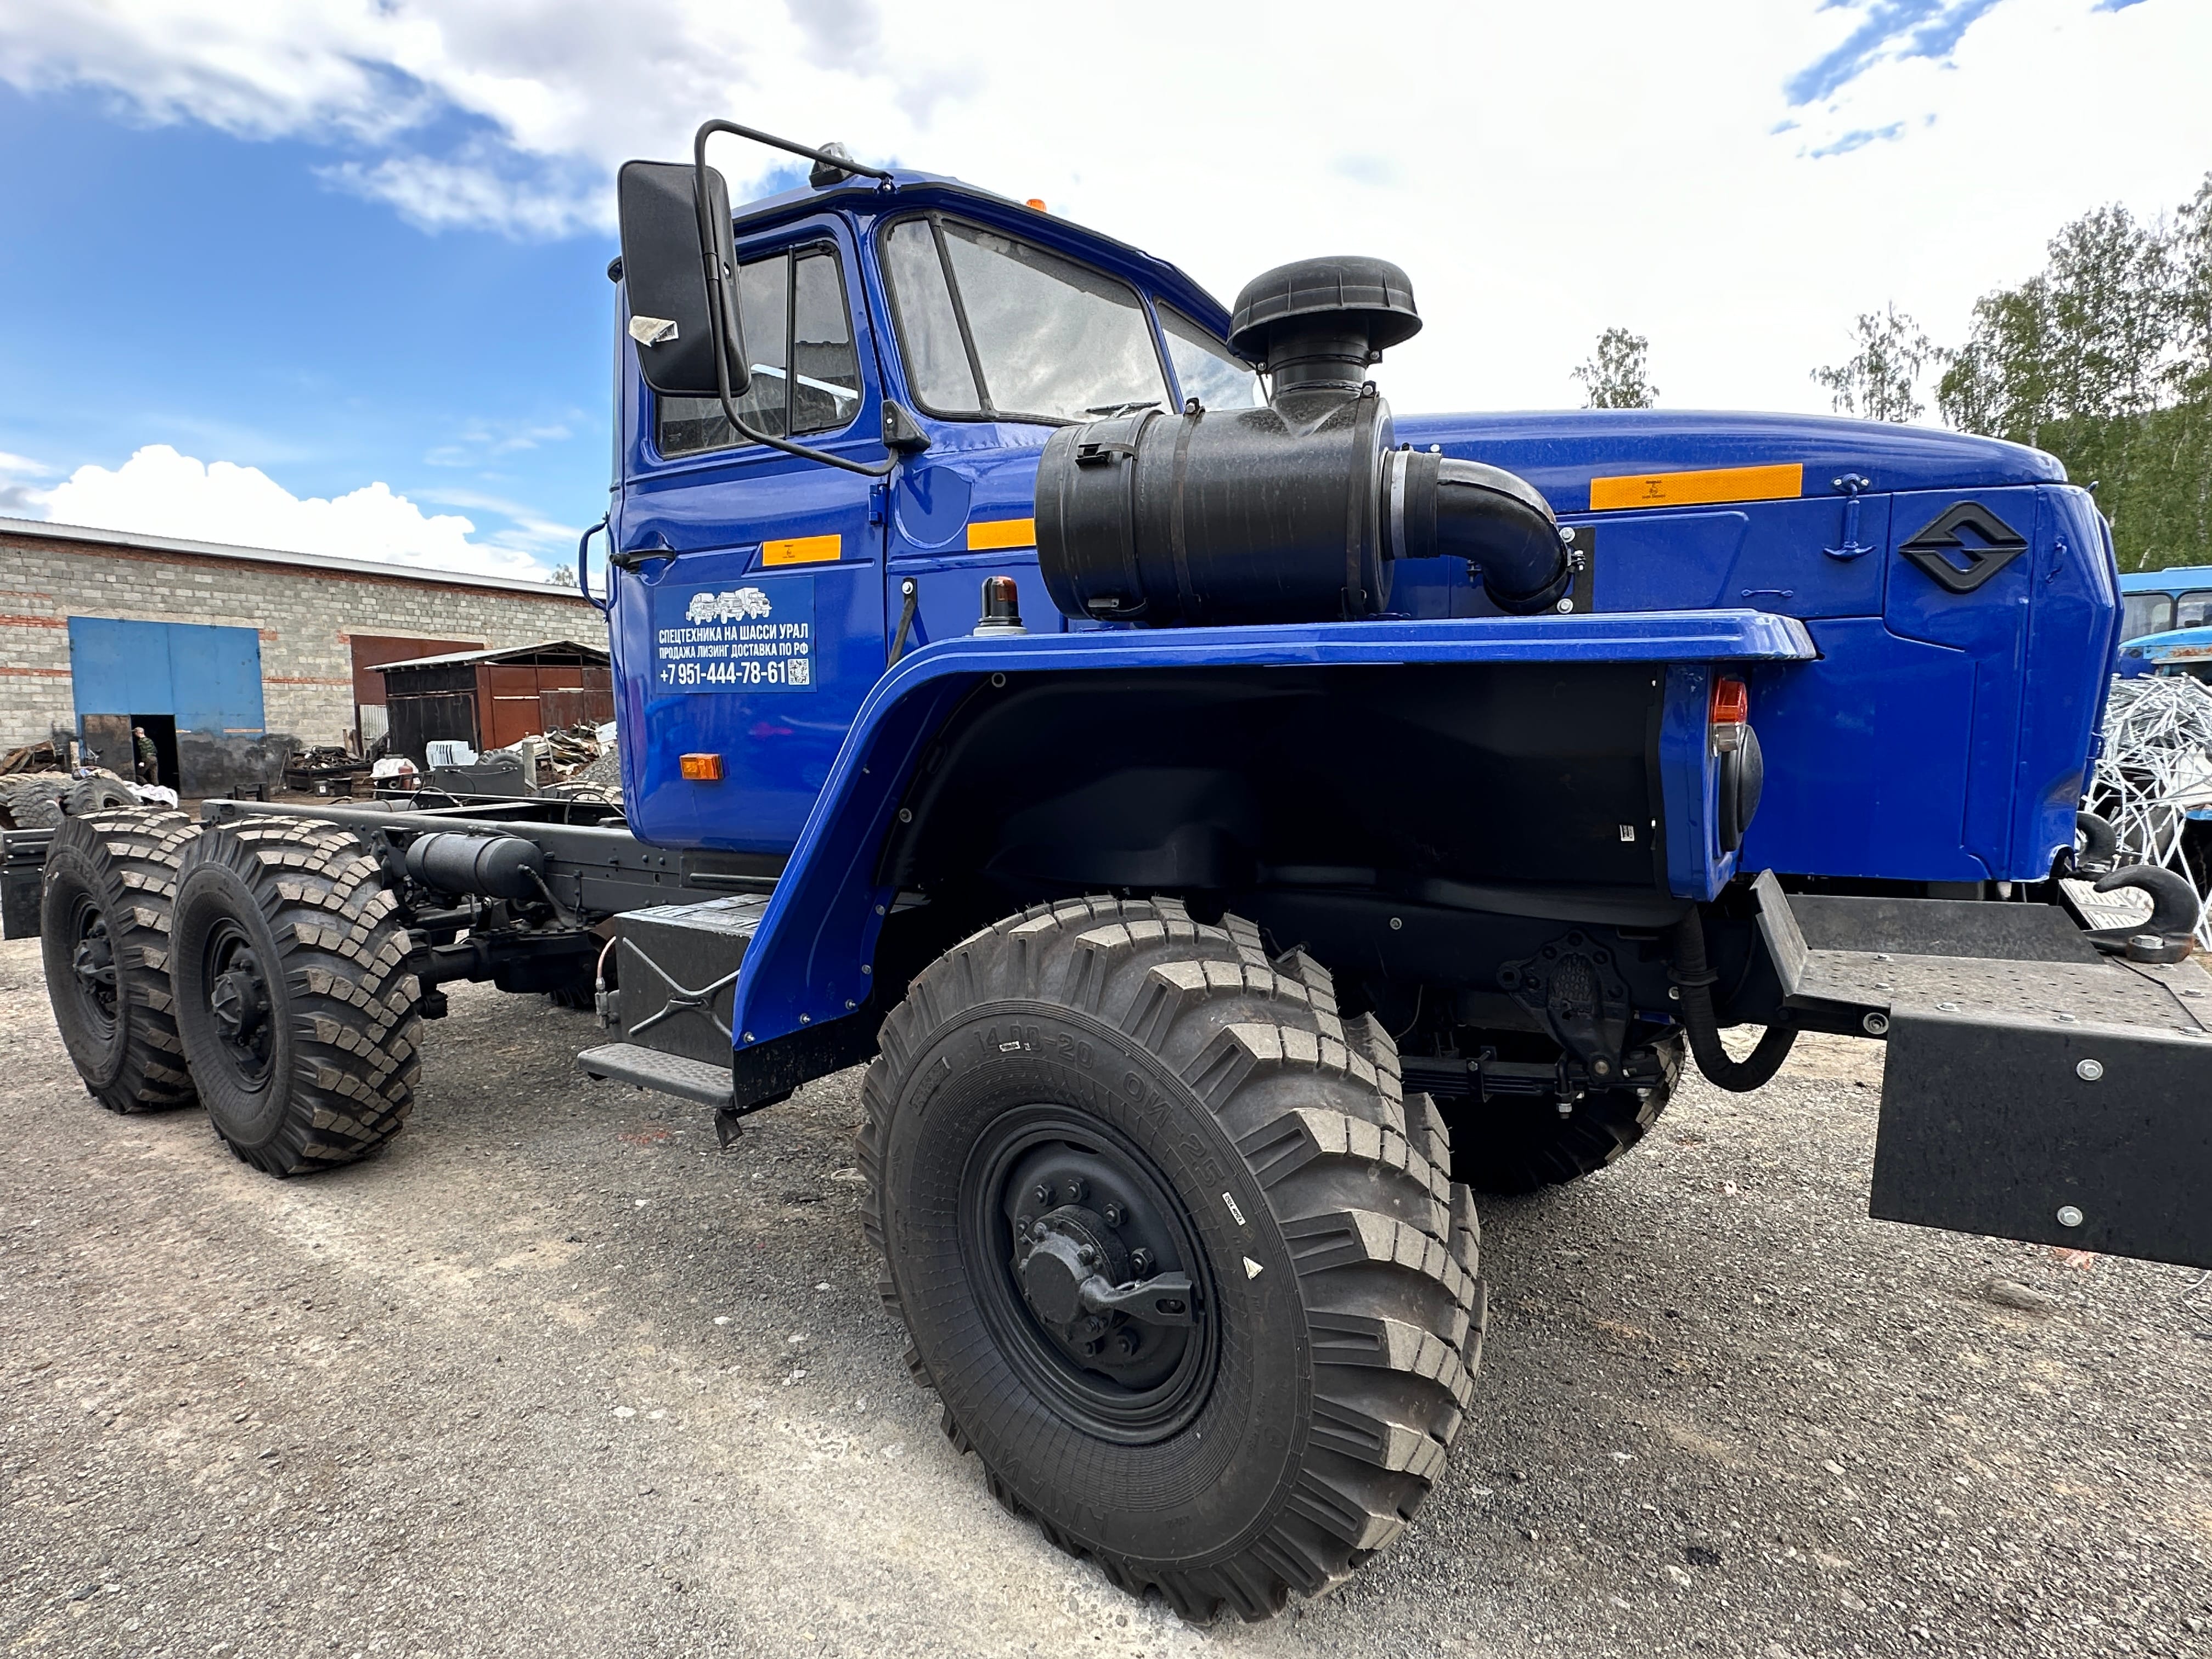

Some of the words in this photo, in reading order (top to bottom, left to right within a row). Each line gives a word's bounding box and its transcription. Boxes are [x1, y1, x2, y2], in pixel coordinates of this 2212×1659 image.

[659, 627, 722, 645] СПЕЦТЕХНИКА
[724, 625, 738, 641] НА
[740, 624, 777, 641] ШАССИ
[779, 623, 808, 640] УРАЛ
[659, 646, 696, 660] ПРОДАЖА
[697, 644, 730, 658] ЛИЗИНГ
[731, 642, 777, 658] ДОСТАВКА
[779, 642, 792, 656] ПО
[793, 641, 809, 656] РФ
[660, 664, 676, 685] +7
[678, 661, 786, 685] 951-444-78-61
[973, 1024, 1094, 1069] 1400-20
